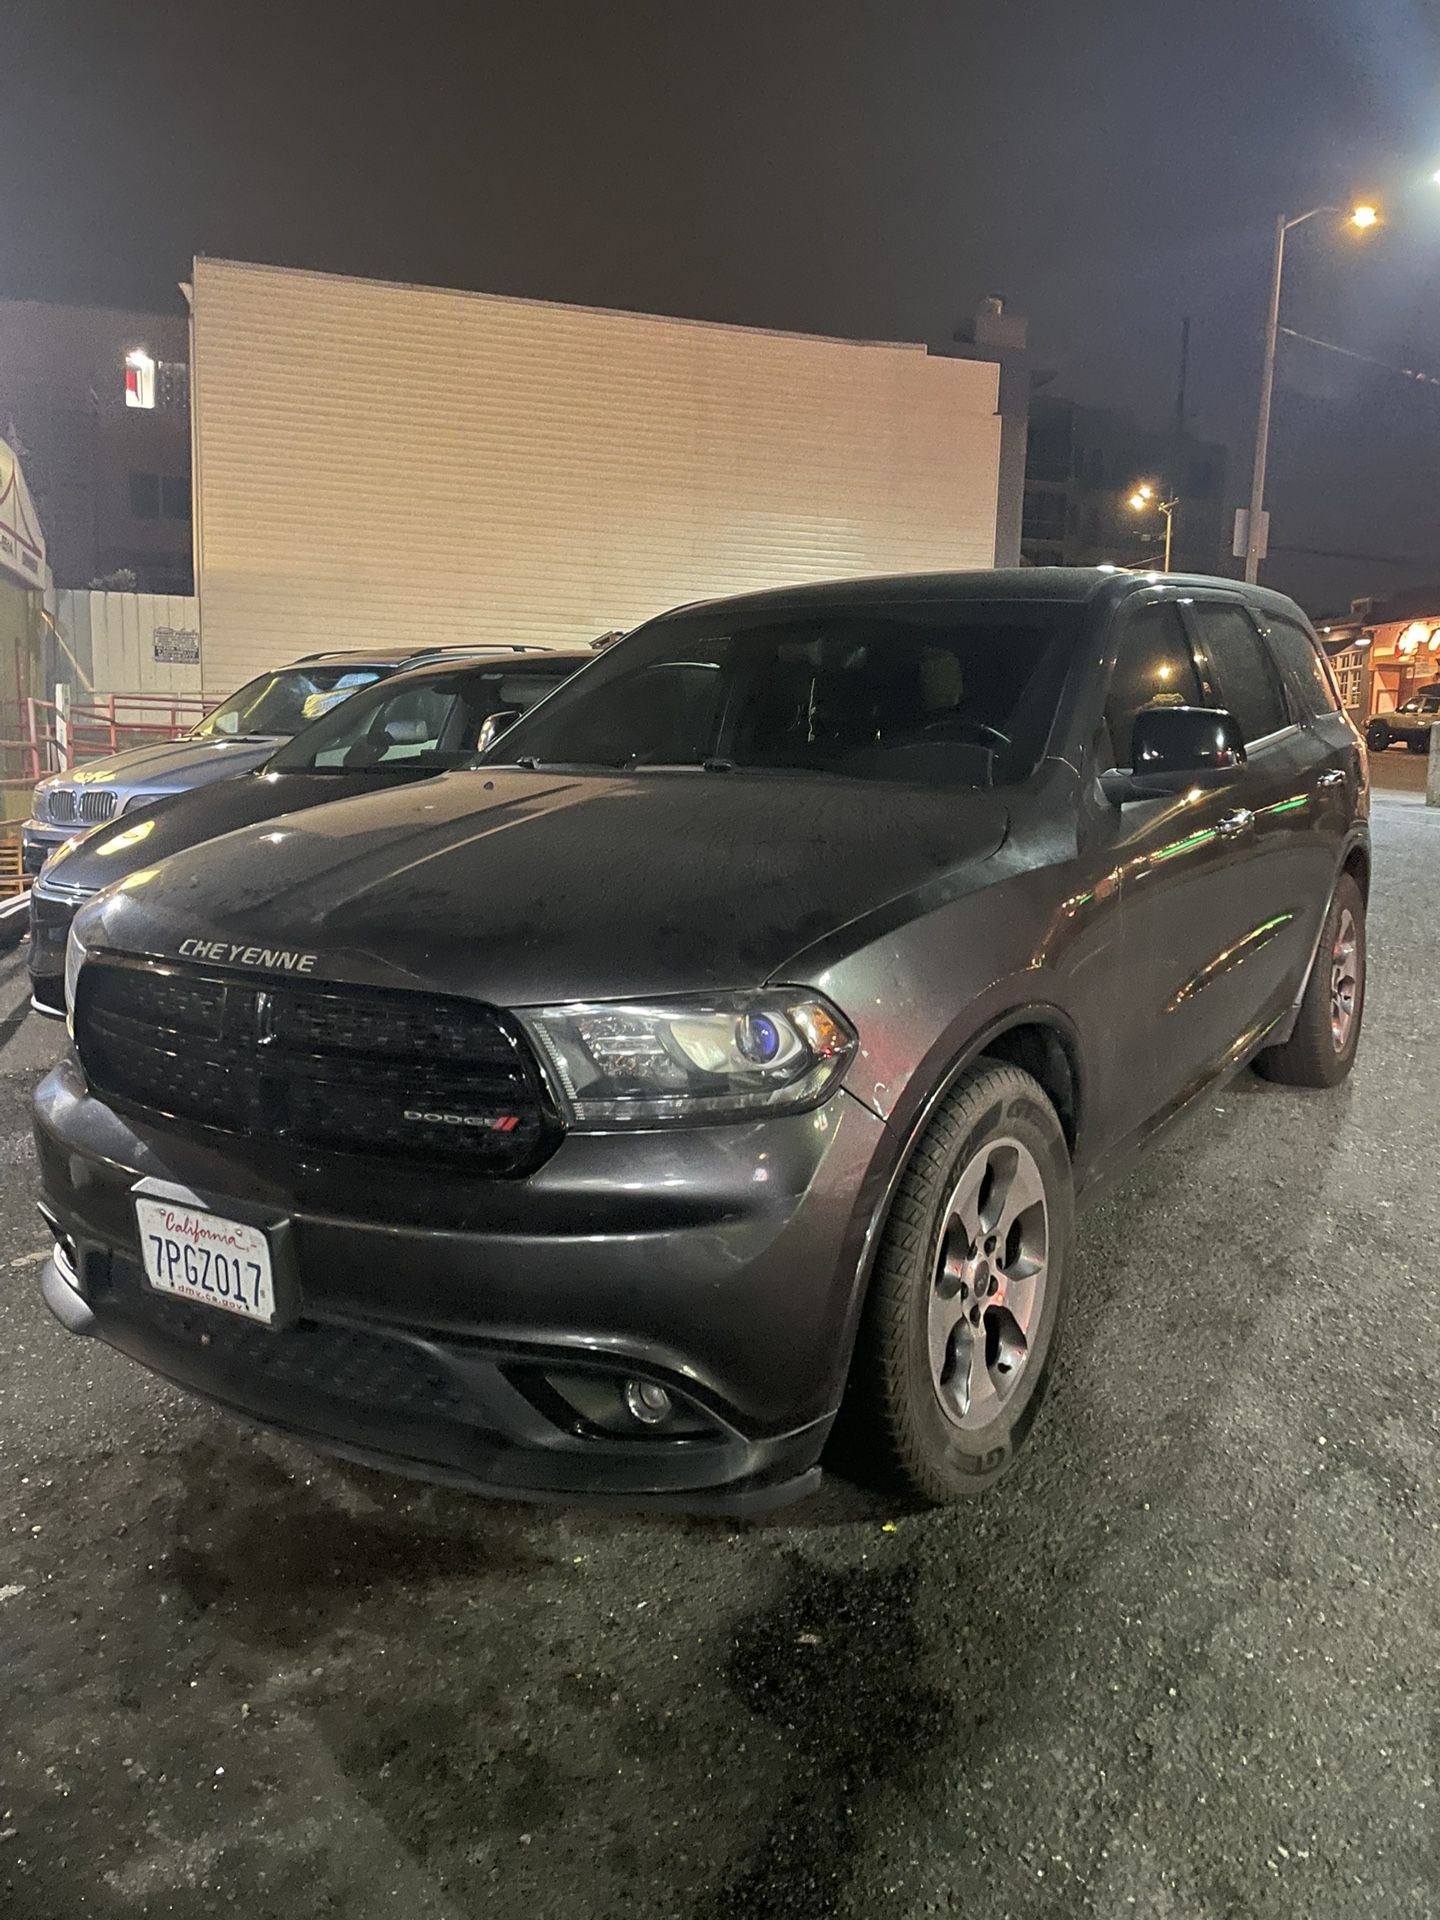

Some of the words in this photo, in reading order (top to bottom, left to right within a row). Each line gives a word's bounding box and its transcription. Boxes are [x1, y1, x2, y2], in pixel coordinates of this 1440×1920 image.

[178, 938, 318, 973] CHEYENNE
[404, 1110, 500, 1127] DODGE
[165, 1212, 250, 1252] California
[149, 1234, 262, 1308] 7PGZ017
